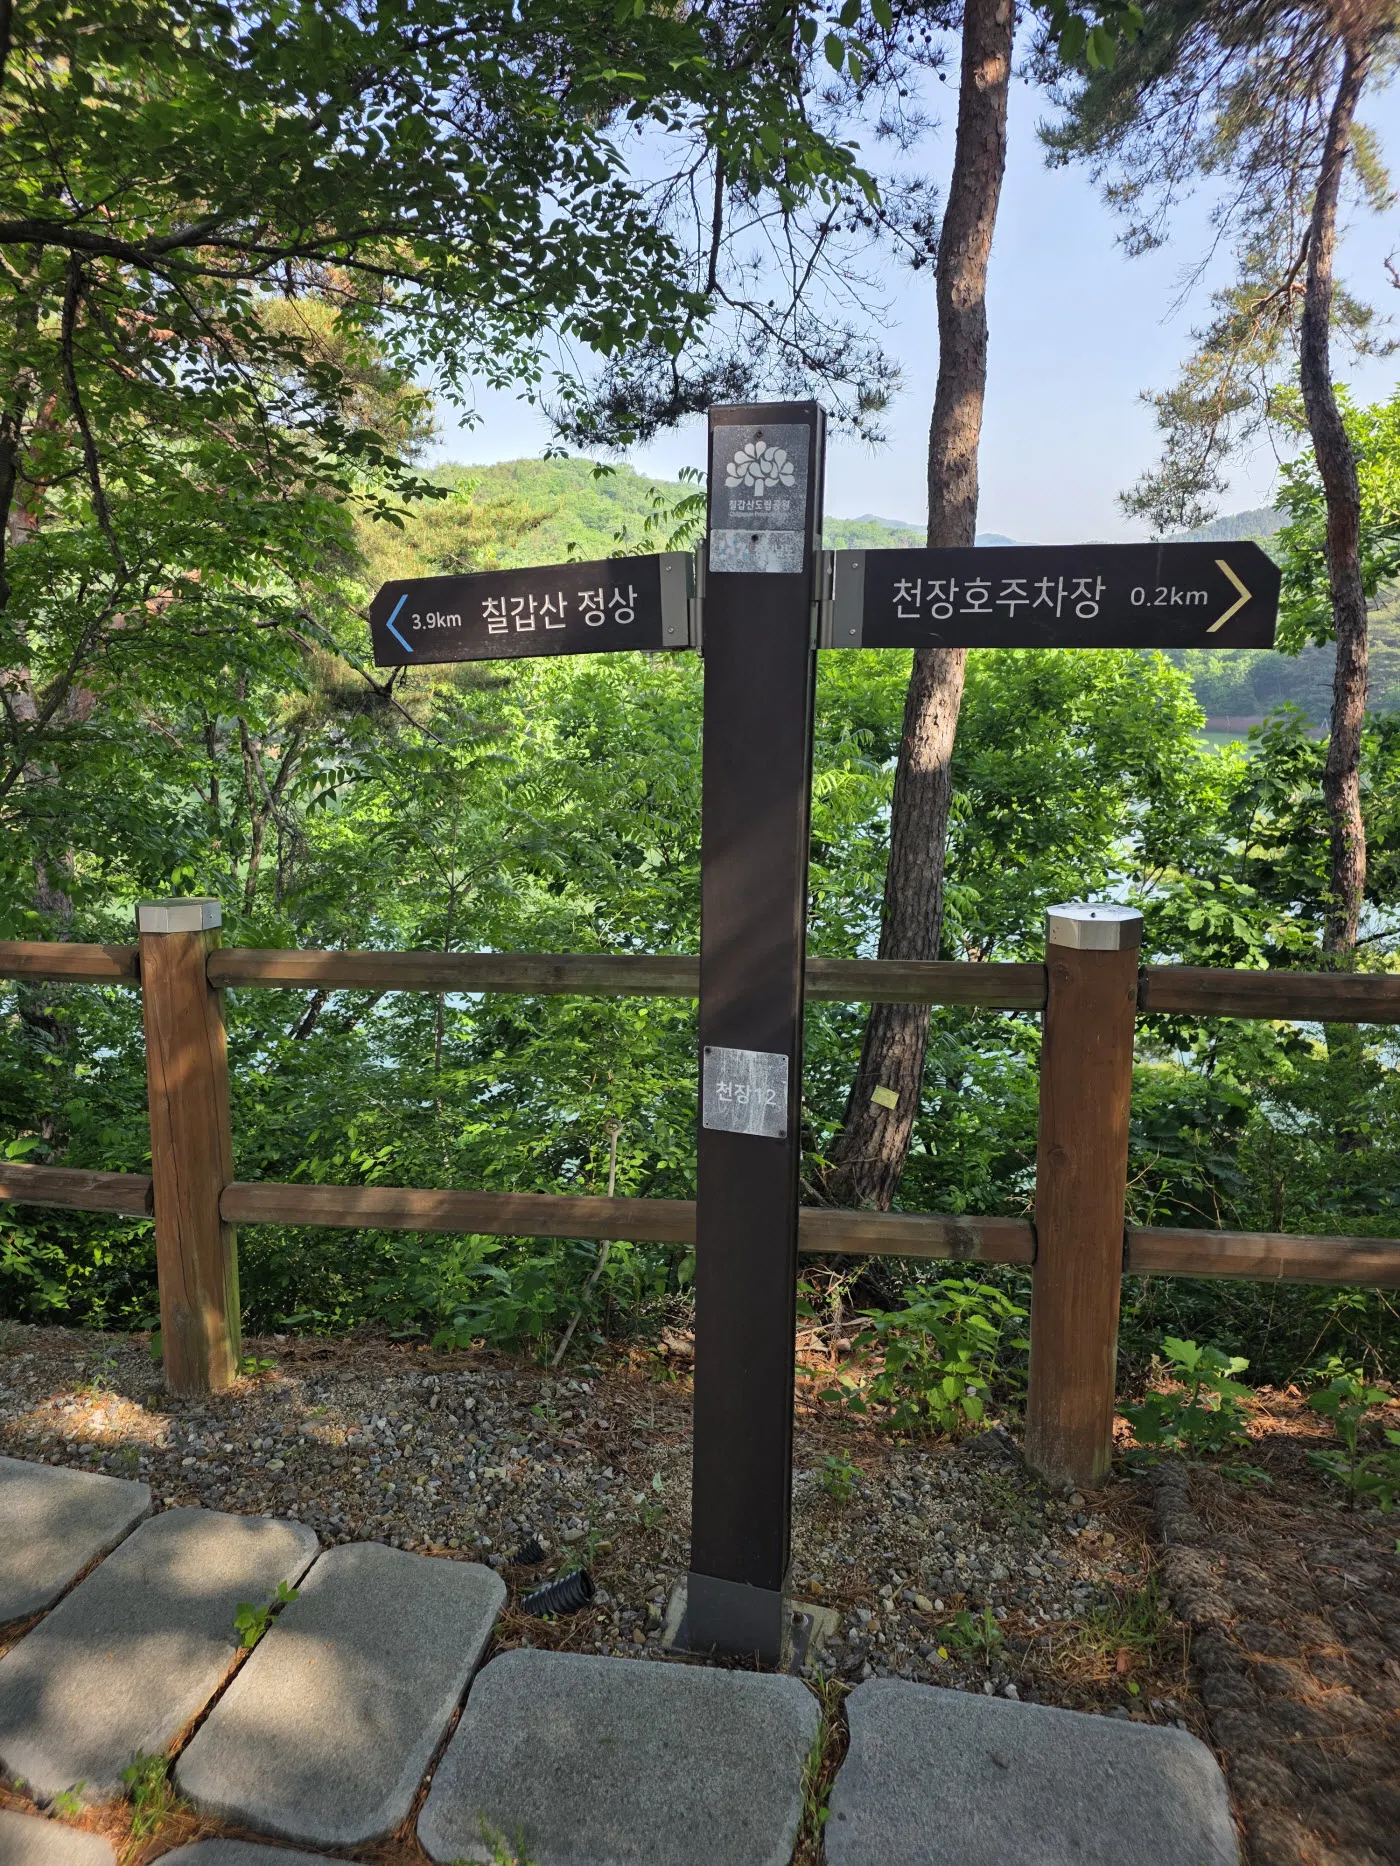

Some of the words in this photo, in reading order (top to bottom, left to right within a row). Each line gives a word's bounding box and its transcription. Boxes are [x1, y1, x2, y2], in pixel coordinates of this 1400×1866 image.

[412, 611, 462, 630] 3.9km
[481, 591, 568, 635] 칠갑산
[577, 584, 638, 627] 정상
[892, 575, 1106, 620] 천장호주차장
[1130, 586, 1209, 607] 0.2km
